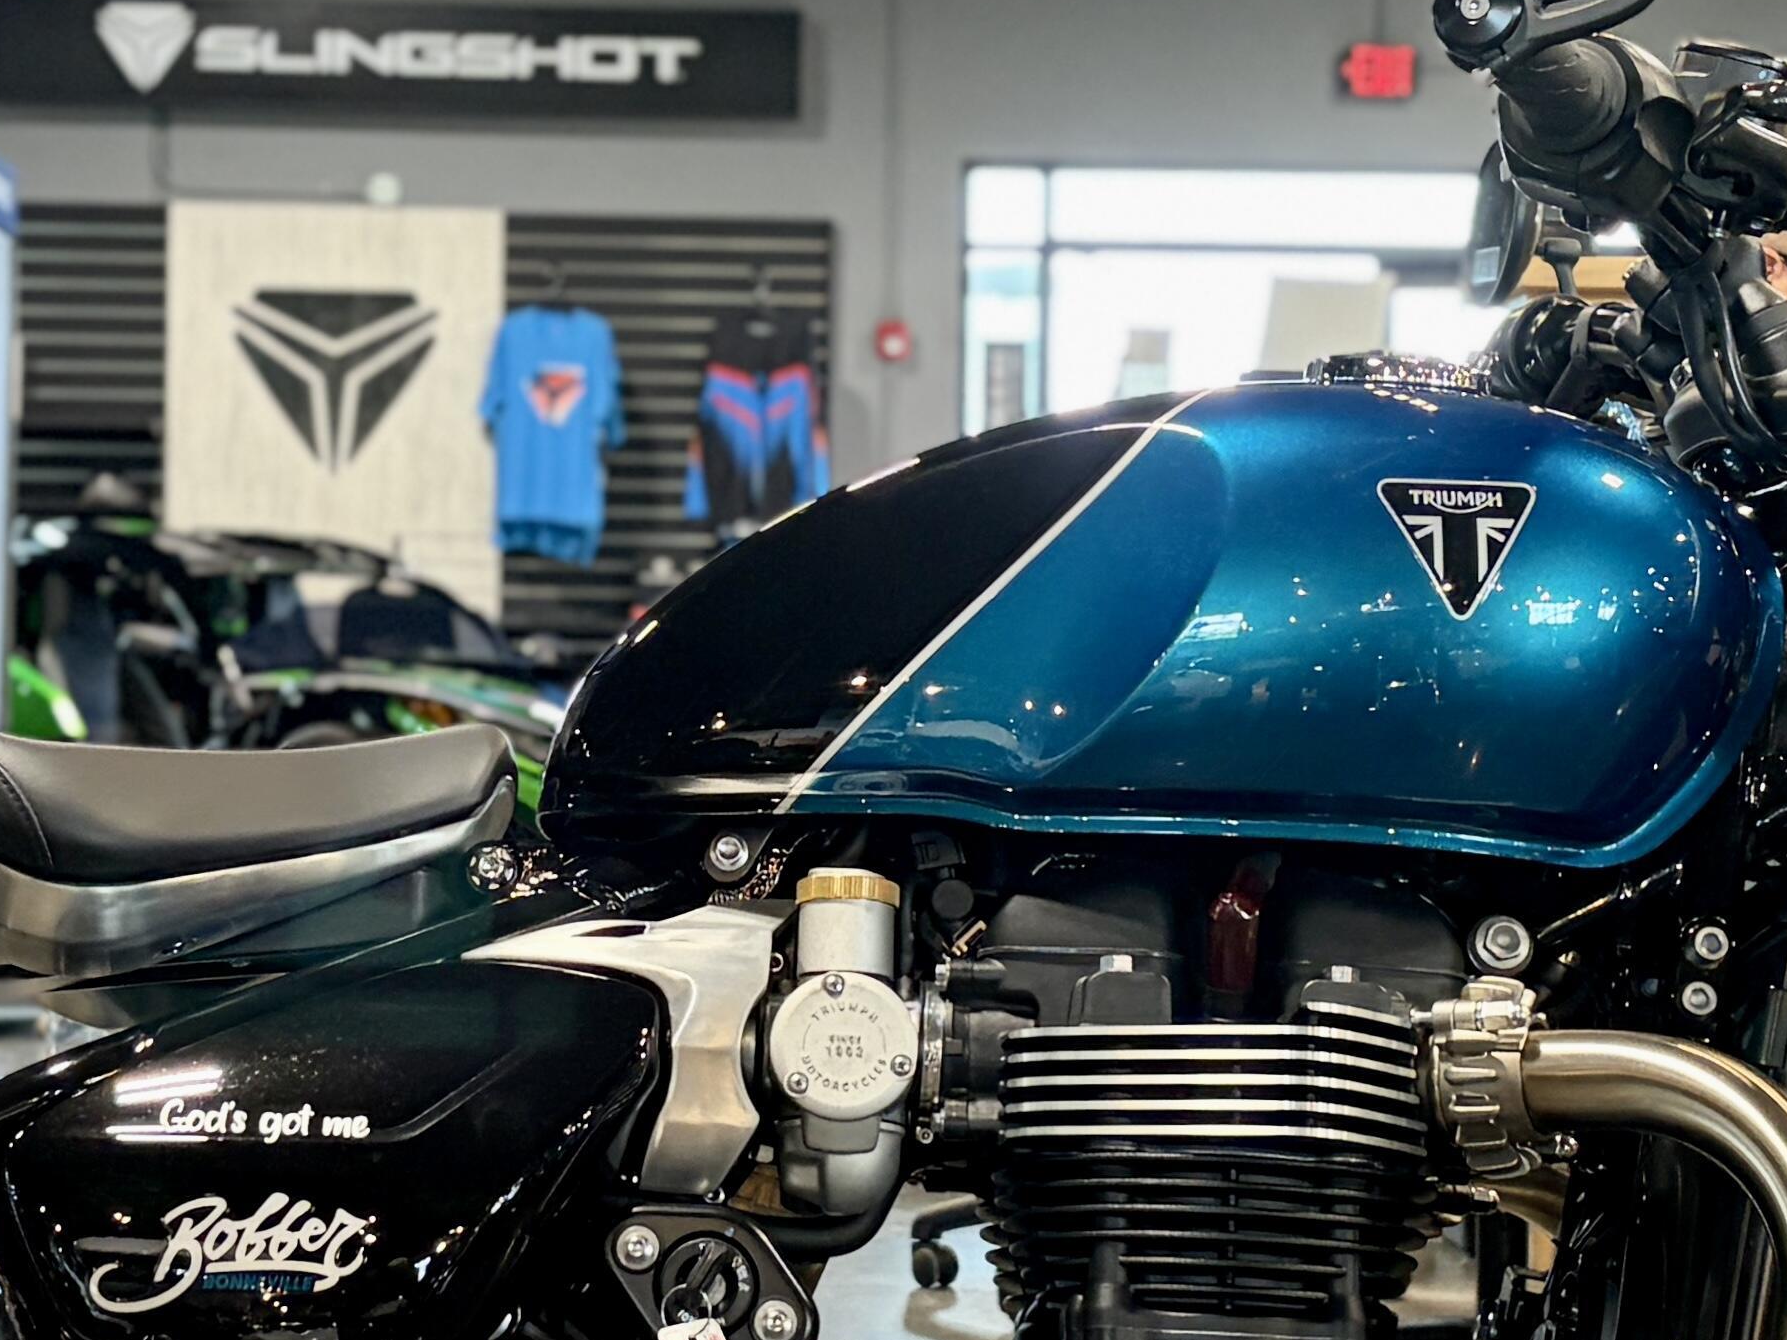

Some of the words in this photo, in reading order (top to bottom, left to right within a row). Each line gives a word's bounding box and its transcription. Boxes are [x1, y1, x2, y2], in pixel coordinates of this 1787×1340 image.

[194, 25, 702, 83] SLINGSHOT
[1407, 486, 1505, 514] TRIUMPH
[812, 1000, 879, 1024] TRIUMPH
[159, 1097, 248, 1134] God's
[258, 1102, 315, 1145] got
[321, 1114, 371, 1139] me
[89, 1191, 370, 1314] Bobber
